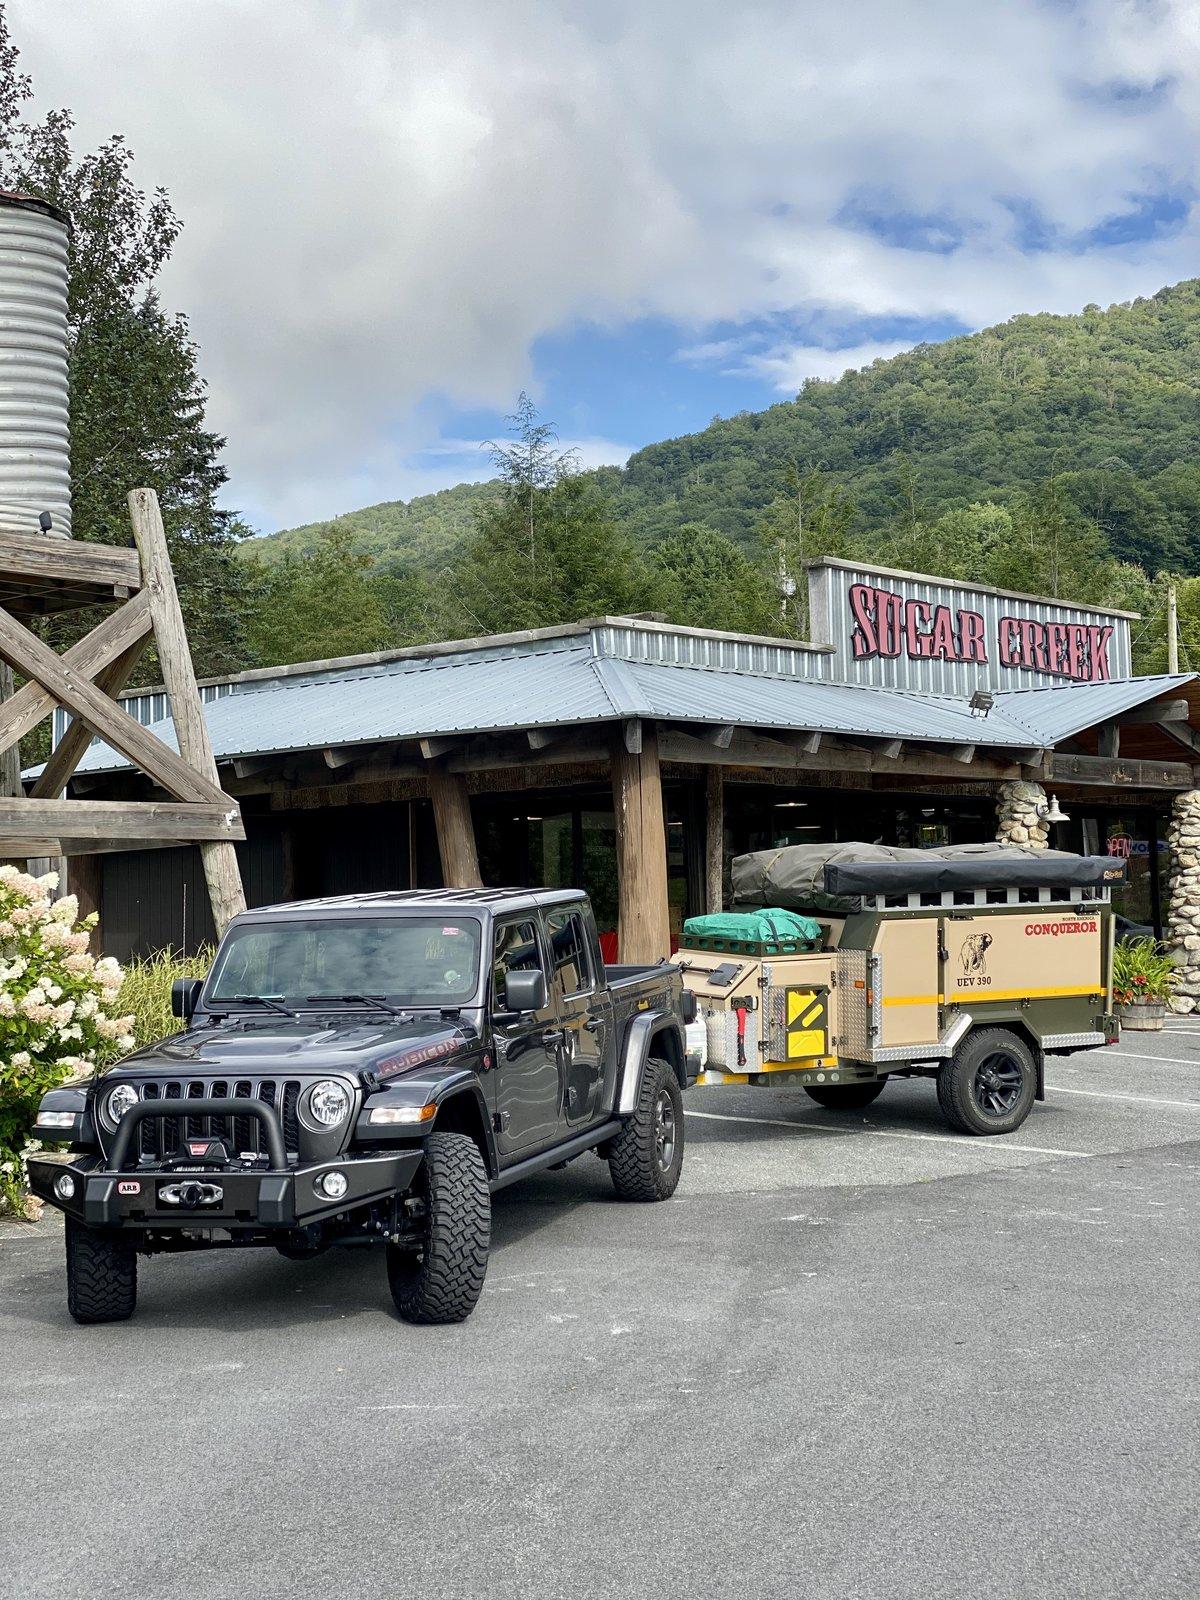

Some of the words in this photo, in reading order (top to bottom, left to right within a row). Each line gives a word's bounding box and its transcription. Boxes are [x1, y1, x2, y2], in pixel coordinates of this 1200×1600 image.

[849, 583, 988, 665] SUGAR
[998, 616, 1114, 682] CREEK
[1106, 838, 1132, 858] OPEN
[1025, 921, 1097, 936] CONQUEROR
[957, 977, 975, 987] UEV
[977, 976, 992, 986] 390
[377, 1039, 460, 1076] RUBICON
[121, 1184, 138, 1192] ARB
